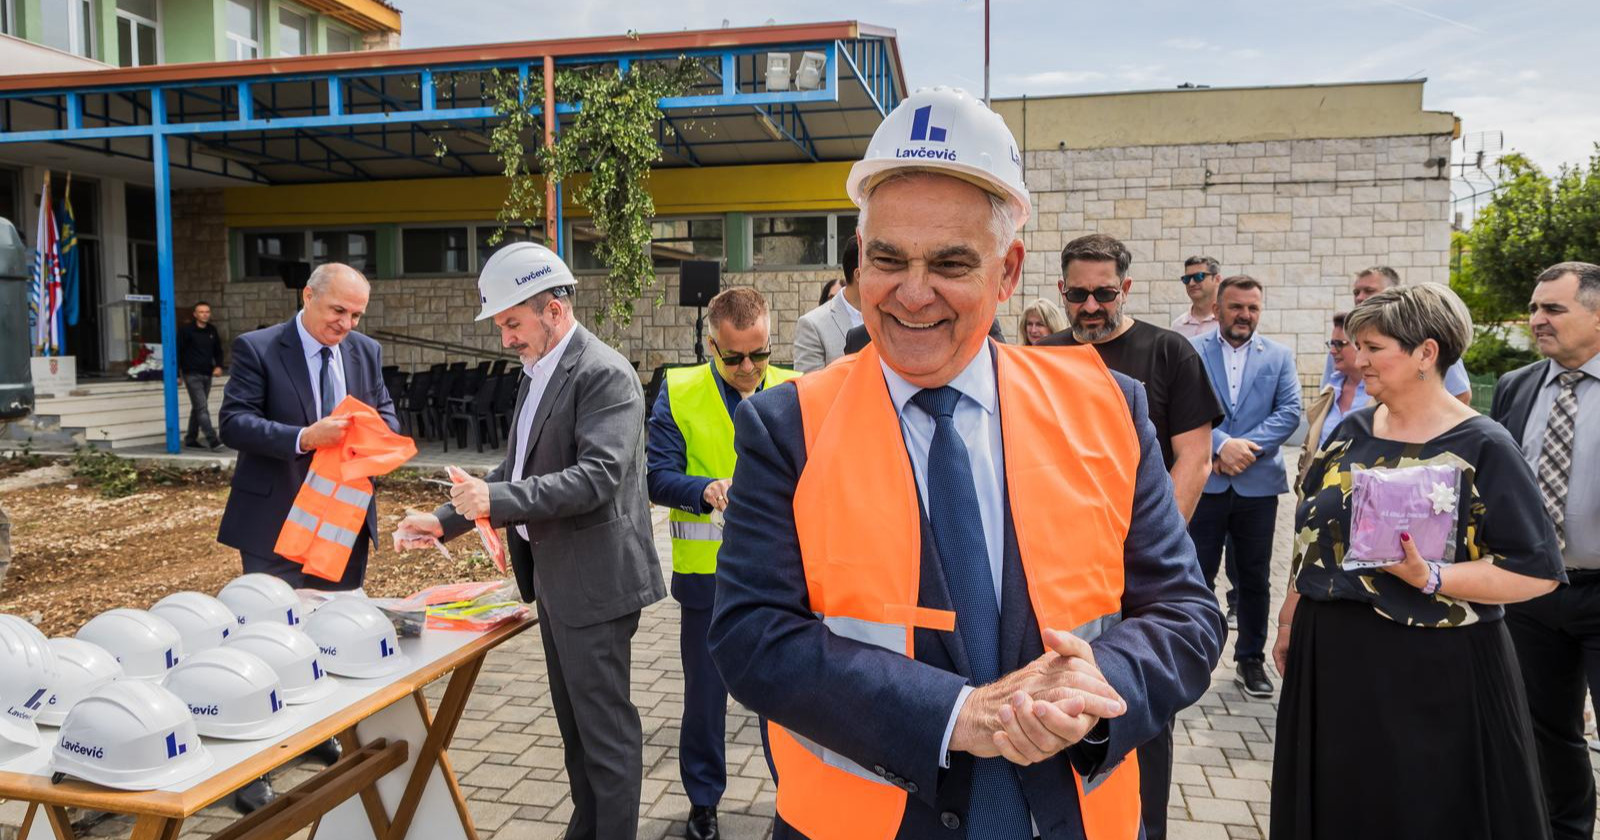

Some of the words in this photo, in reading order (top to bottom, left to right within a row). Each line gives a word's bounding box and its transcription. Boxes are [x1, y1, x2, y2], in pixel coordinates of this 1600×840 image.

[896, 147, 956, 161] Lavčević
[515, 265, 552, 286] Lavčević
[61, 736, 104, 759] Lavčević
